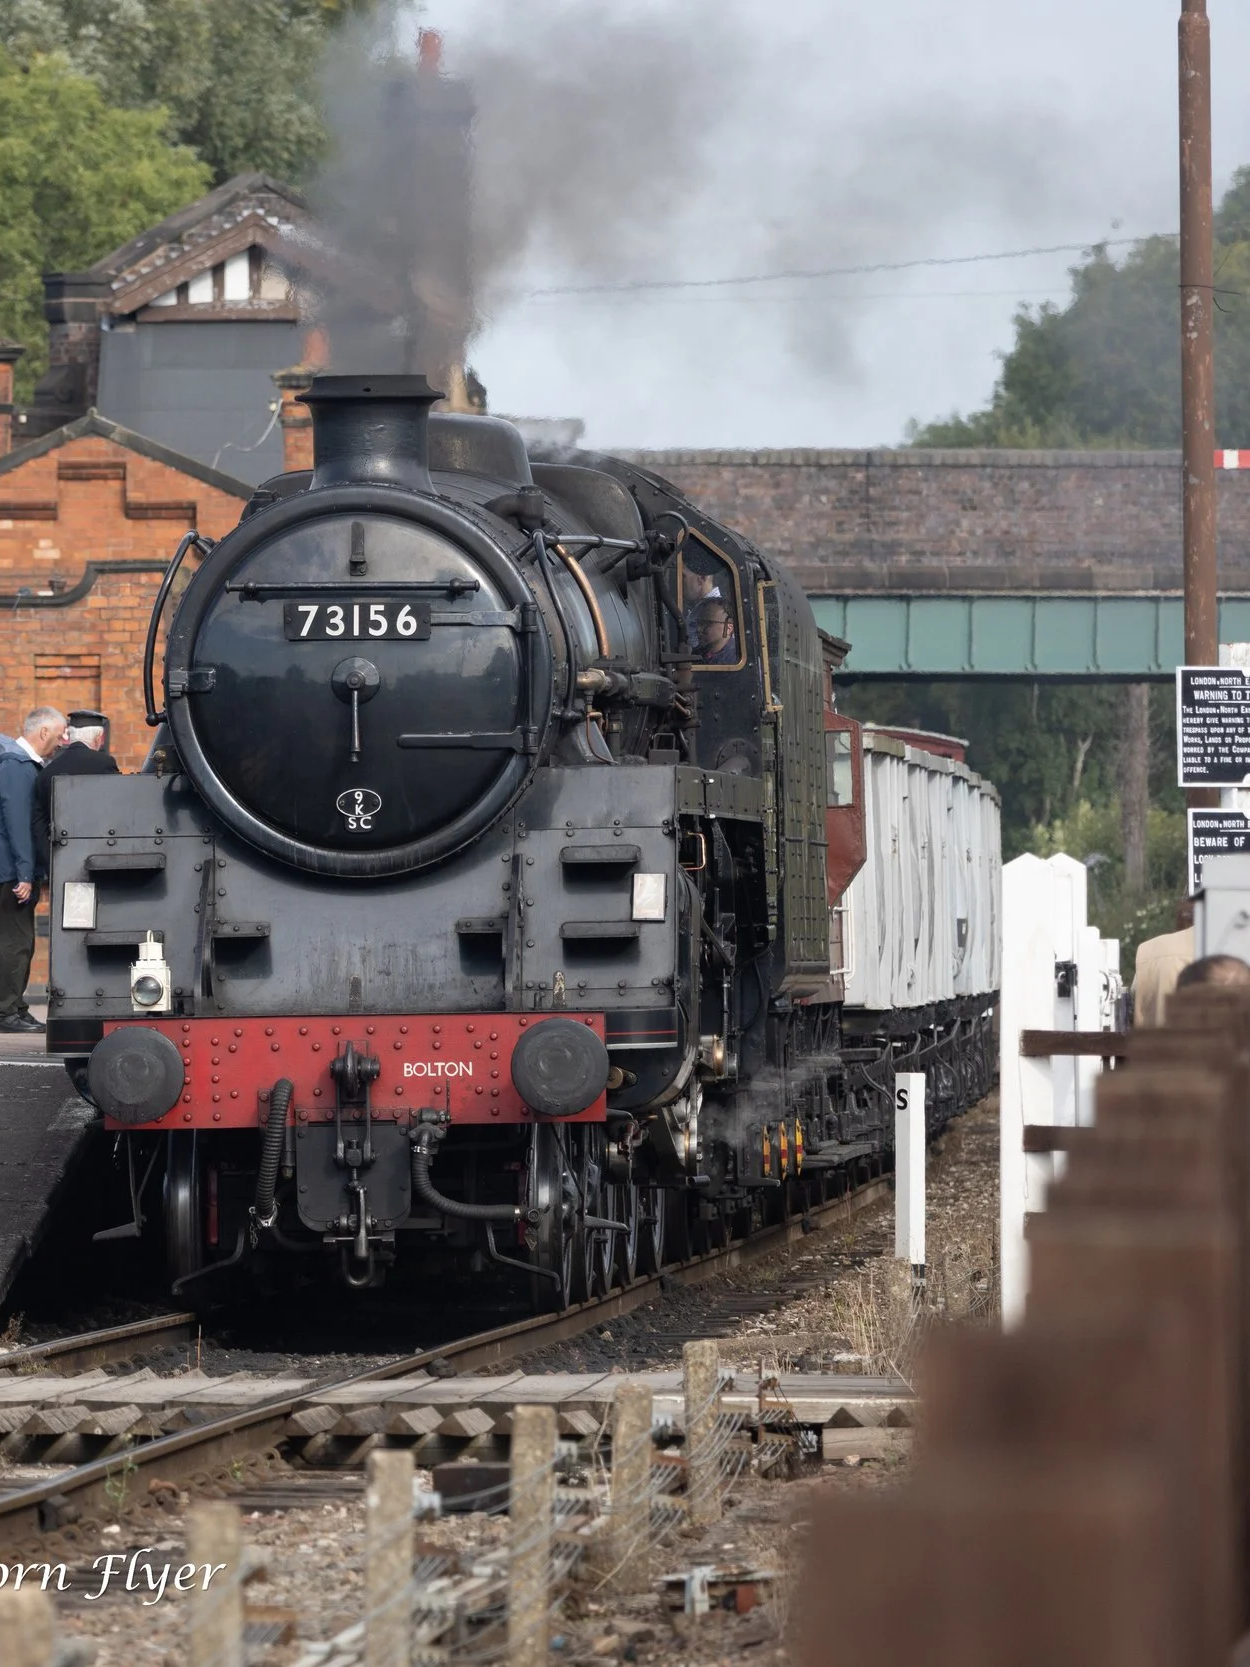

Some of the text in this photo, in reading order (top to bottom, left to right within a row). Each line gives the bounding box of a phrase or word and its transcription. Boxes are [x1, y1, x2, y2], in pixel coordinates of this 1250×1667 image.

[297, 604, 417, 637] 73156
[1193, 690, 1228, 700] WARNING
[1231, 690, 1242, 700] TO
[354, 791, 363, 804] 9
[355, 804, 364, 815] K
[348, 816, 372, 829] SC
[1193, 836, 1245, 847] BEWARE OF
[403, 1061, 473, 1077] BOLTON
[896, 1088, 908, 1110] S
